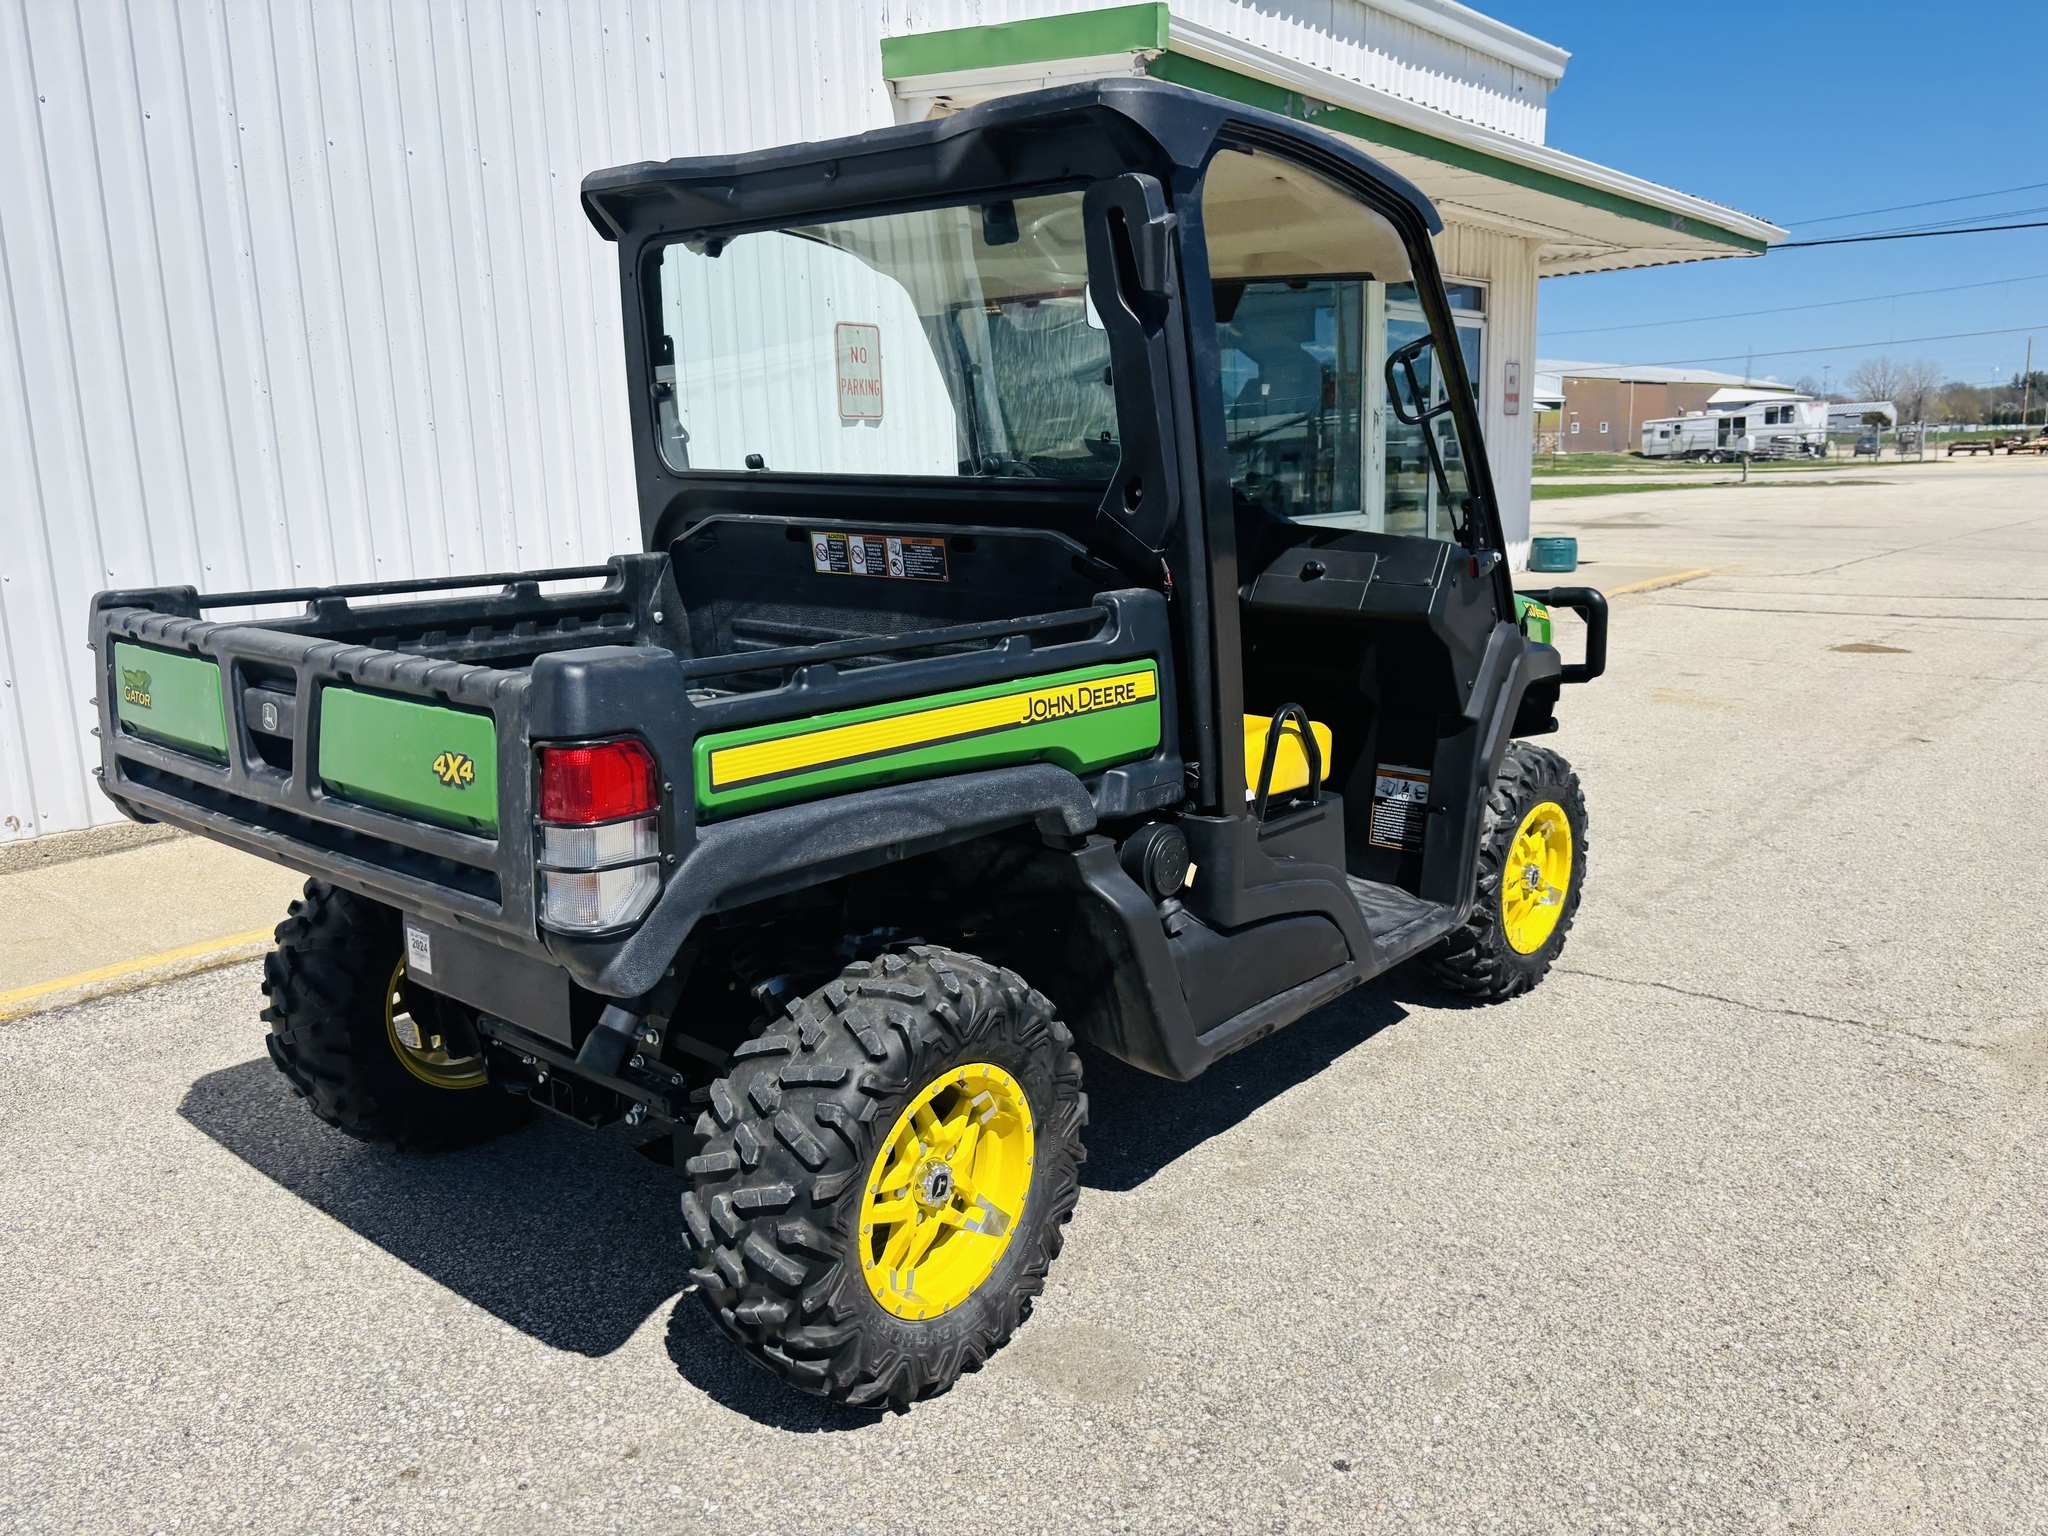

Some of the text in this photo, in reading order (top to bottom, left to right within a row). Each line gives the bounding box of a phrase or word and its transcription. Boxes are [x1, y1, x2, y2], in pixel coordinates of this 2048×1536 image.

[850, 346, 867, 364] NO
[841, 378, 880, 396] PARKING
[124, 684, 152, 709] GATOR
[1022, 682, 1136, 721] JOHN DEERE
[411, 937, 428, 953] 2024
